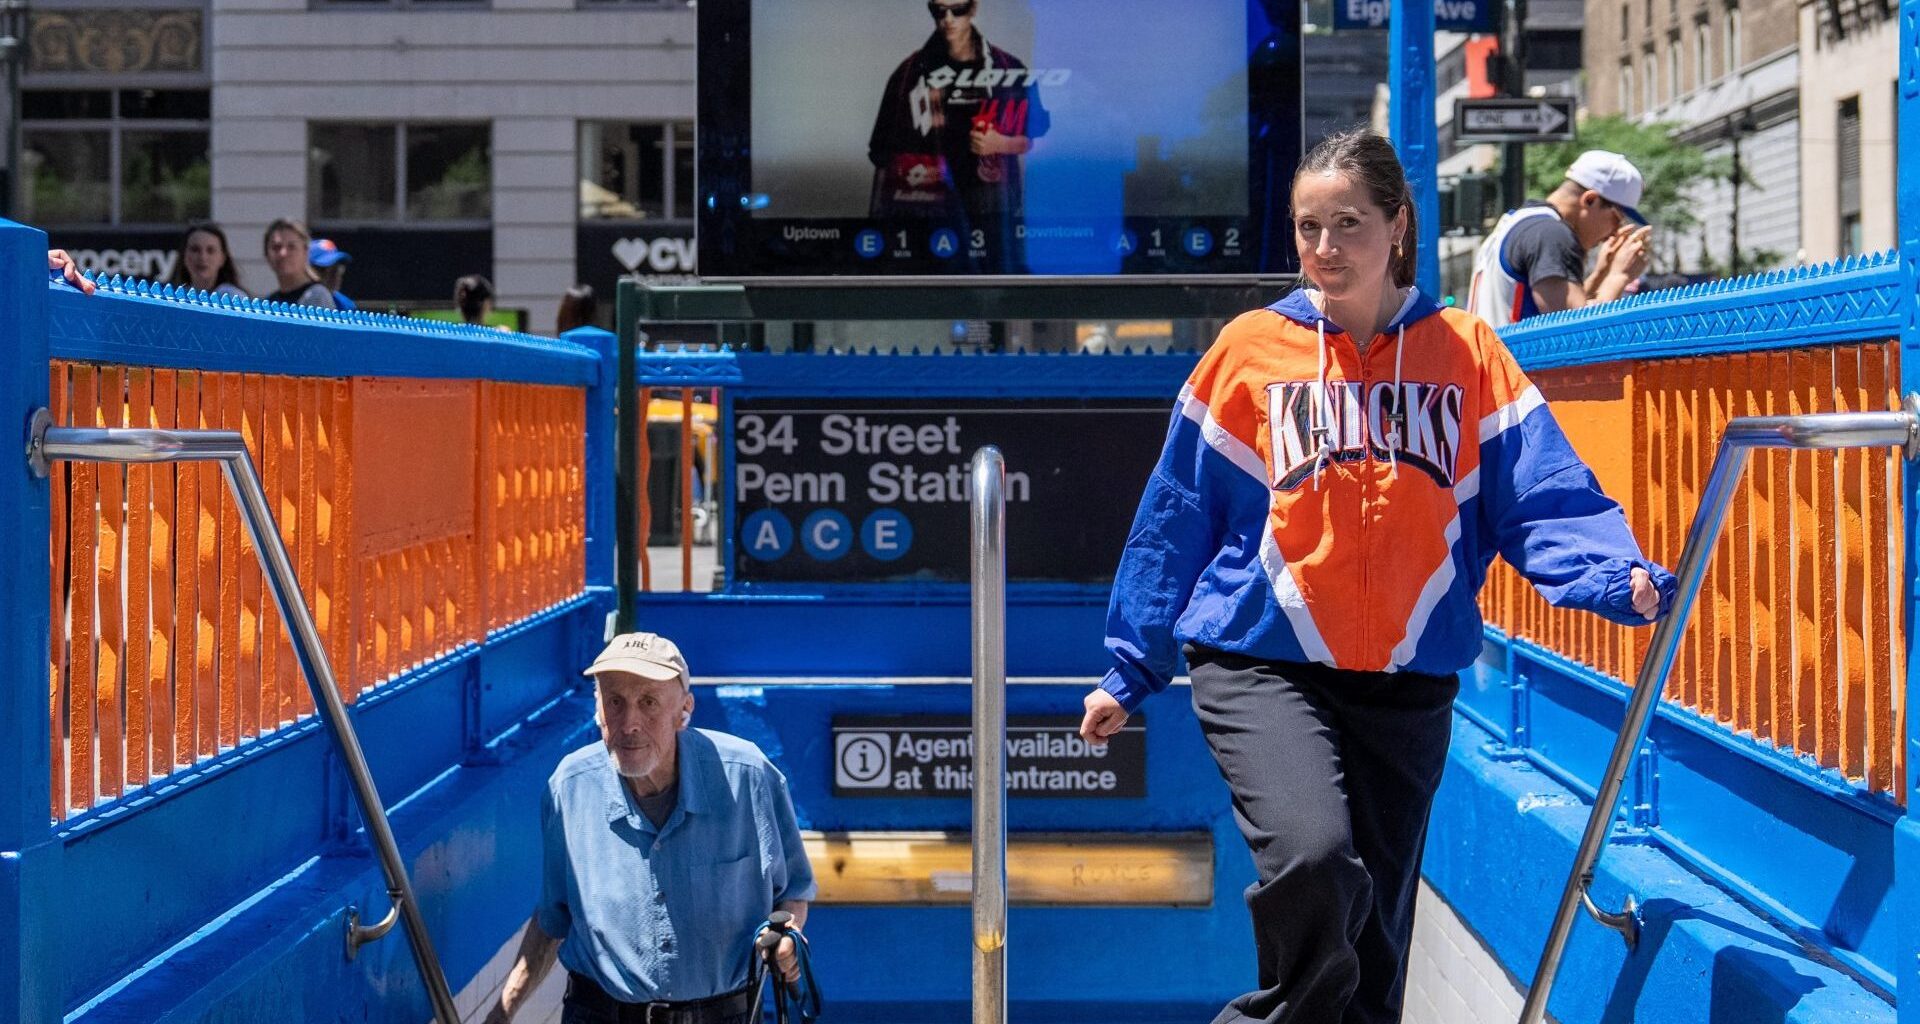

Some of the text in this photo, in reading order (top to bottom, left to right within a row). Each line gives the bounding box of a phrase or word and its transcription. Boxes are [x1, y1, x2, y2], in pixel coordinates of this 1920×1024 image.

[1347, 0, 1476, 26] Eig Ave
[954, 69, 1072, 87] LOTTO
[783, 226, 985, 252] Uptown E 1 A 3
[1015, 225, 1239, 250] Downtown A 1 E 2
[648, 237, 696, 271] CV
[736, 414, 961, 455] 34 Street
[1266, 380, 1464, 489] KNICKS
[736, 462, 1030, 502] Penn Statin
[754, 519, 898, 550] A C E
[894, 732, 1108, 762] Agent vailable
[894, 766, 922, 790] at
